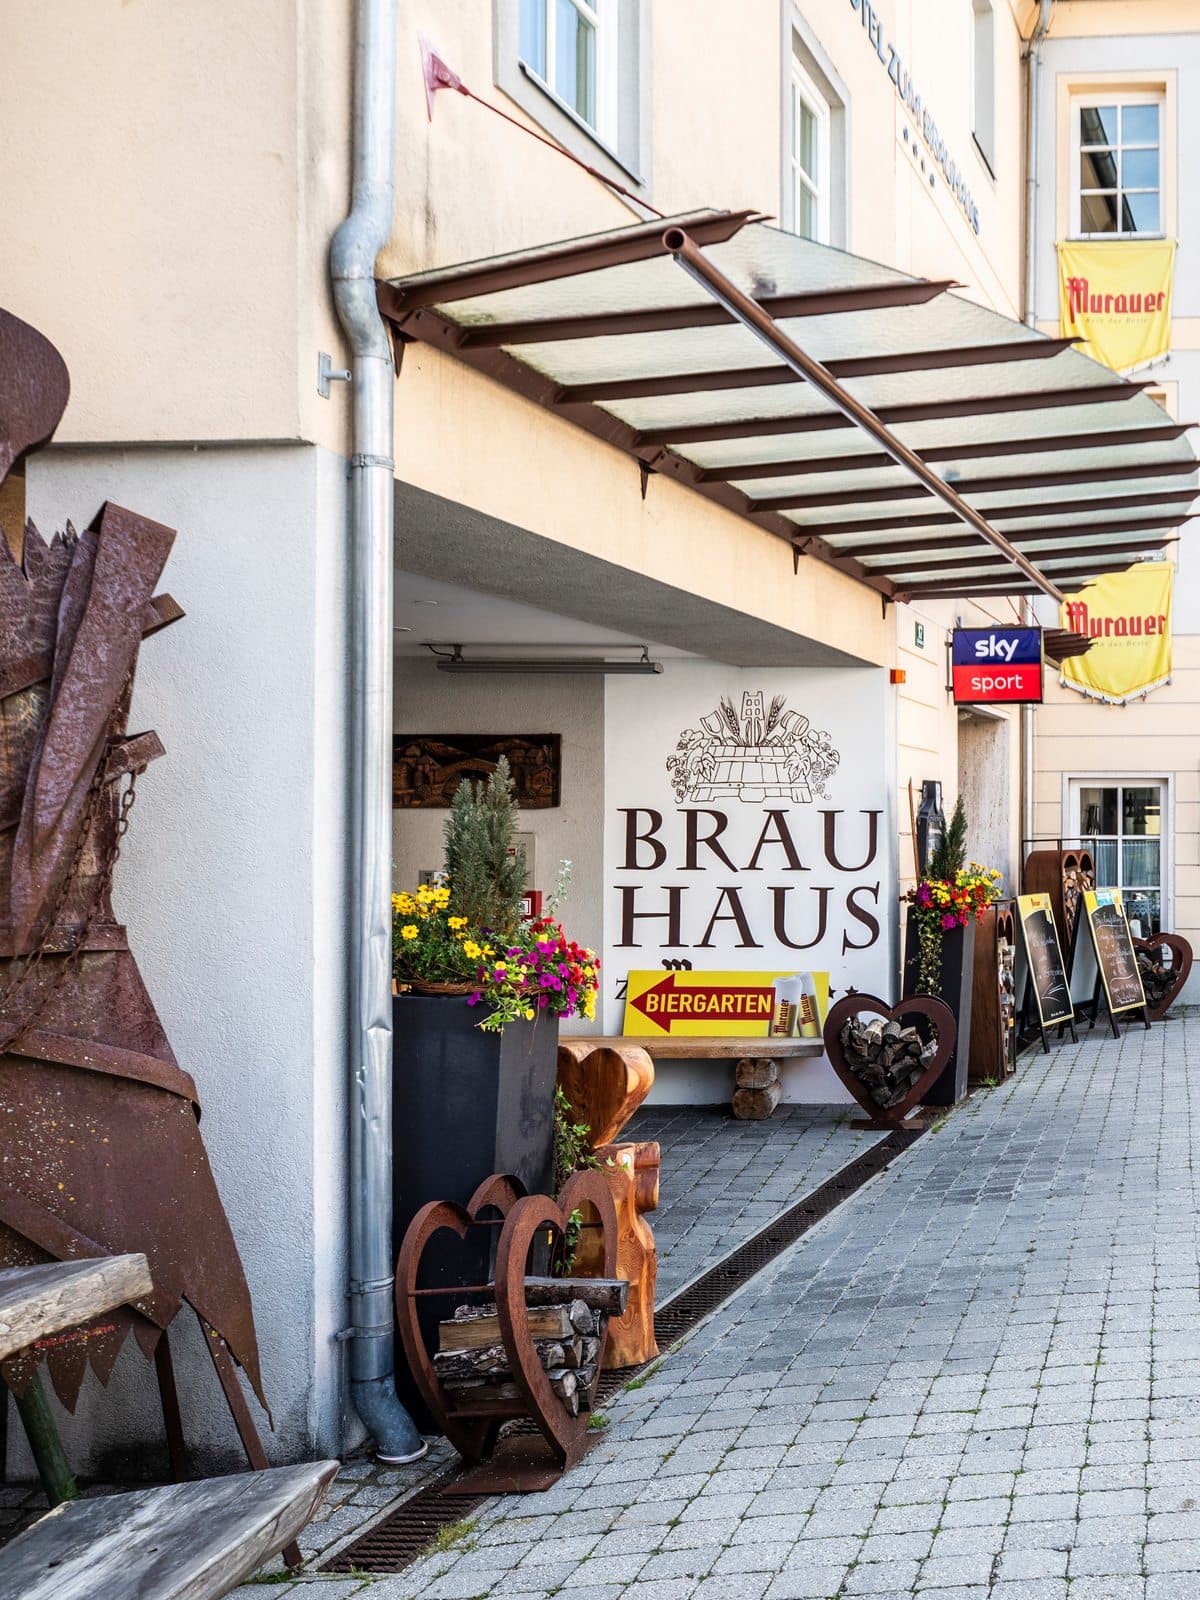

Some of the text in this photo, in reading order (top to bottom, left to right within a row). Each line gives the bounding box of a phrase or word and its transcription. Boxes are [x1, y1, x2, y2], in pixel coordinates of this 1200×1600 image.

[888, 42, 920, 129] ZUM
[1065, 276, 1166, 325] Murauer
[1066, 601, 1166, 637] Murauer
[975, 635, 1019, 662] sky
[971, 673, 1023, 693] sport
[616, 808, 884, 872] BRAU
[612, 881, 880, 956] HAUS
[646, 993, 772, 1013] BIERGARTEN
[773, 999, 790, 1034] Murauer
[800, 993, 815, 1025] Murauer
